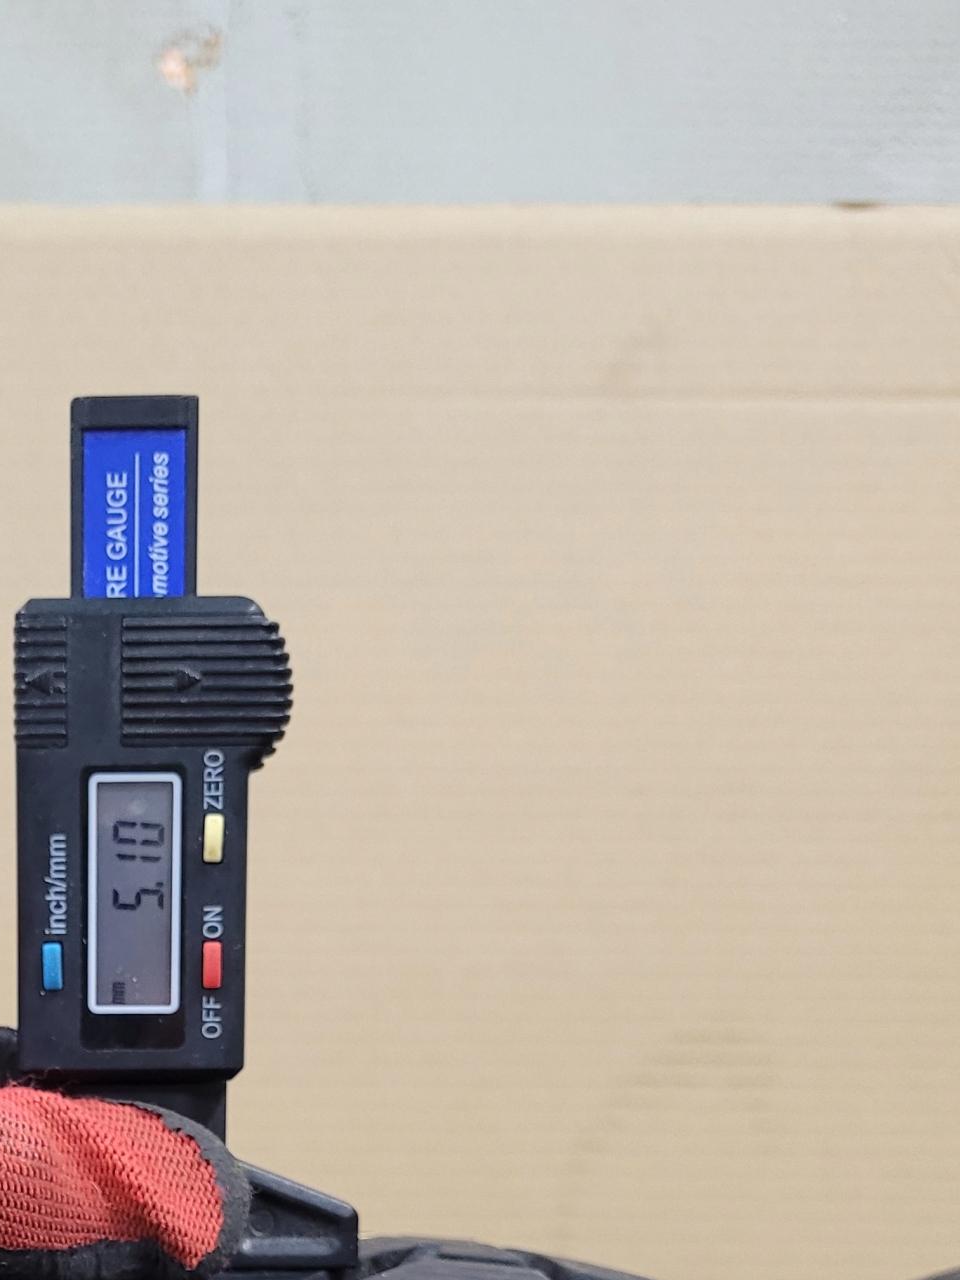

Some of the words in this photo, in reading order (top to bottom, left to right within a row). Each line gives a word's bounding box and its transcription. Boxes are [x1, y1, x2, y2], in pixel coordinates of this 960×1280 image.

[106, 472, 127, 561] GAUGE
[148, 452, 169, 519] series
[147, 521, 169, 598] motive
[203, 750, 225, 810] ZERO
[44, 833, 67, 935] inch/mm
[112, 820, 165, 910] 5.10
[202, 905, 224, 939] ON
[201, 996, 223, 1039] OFF
